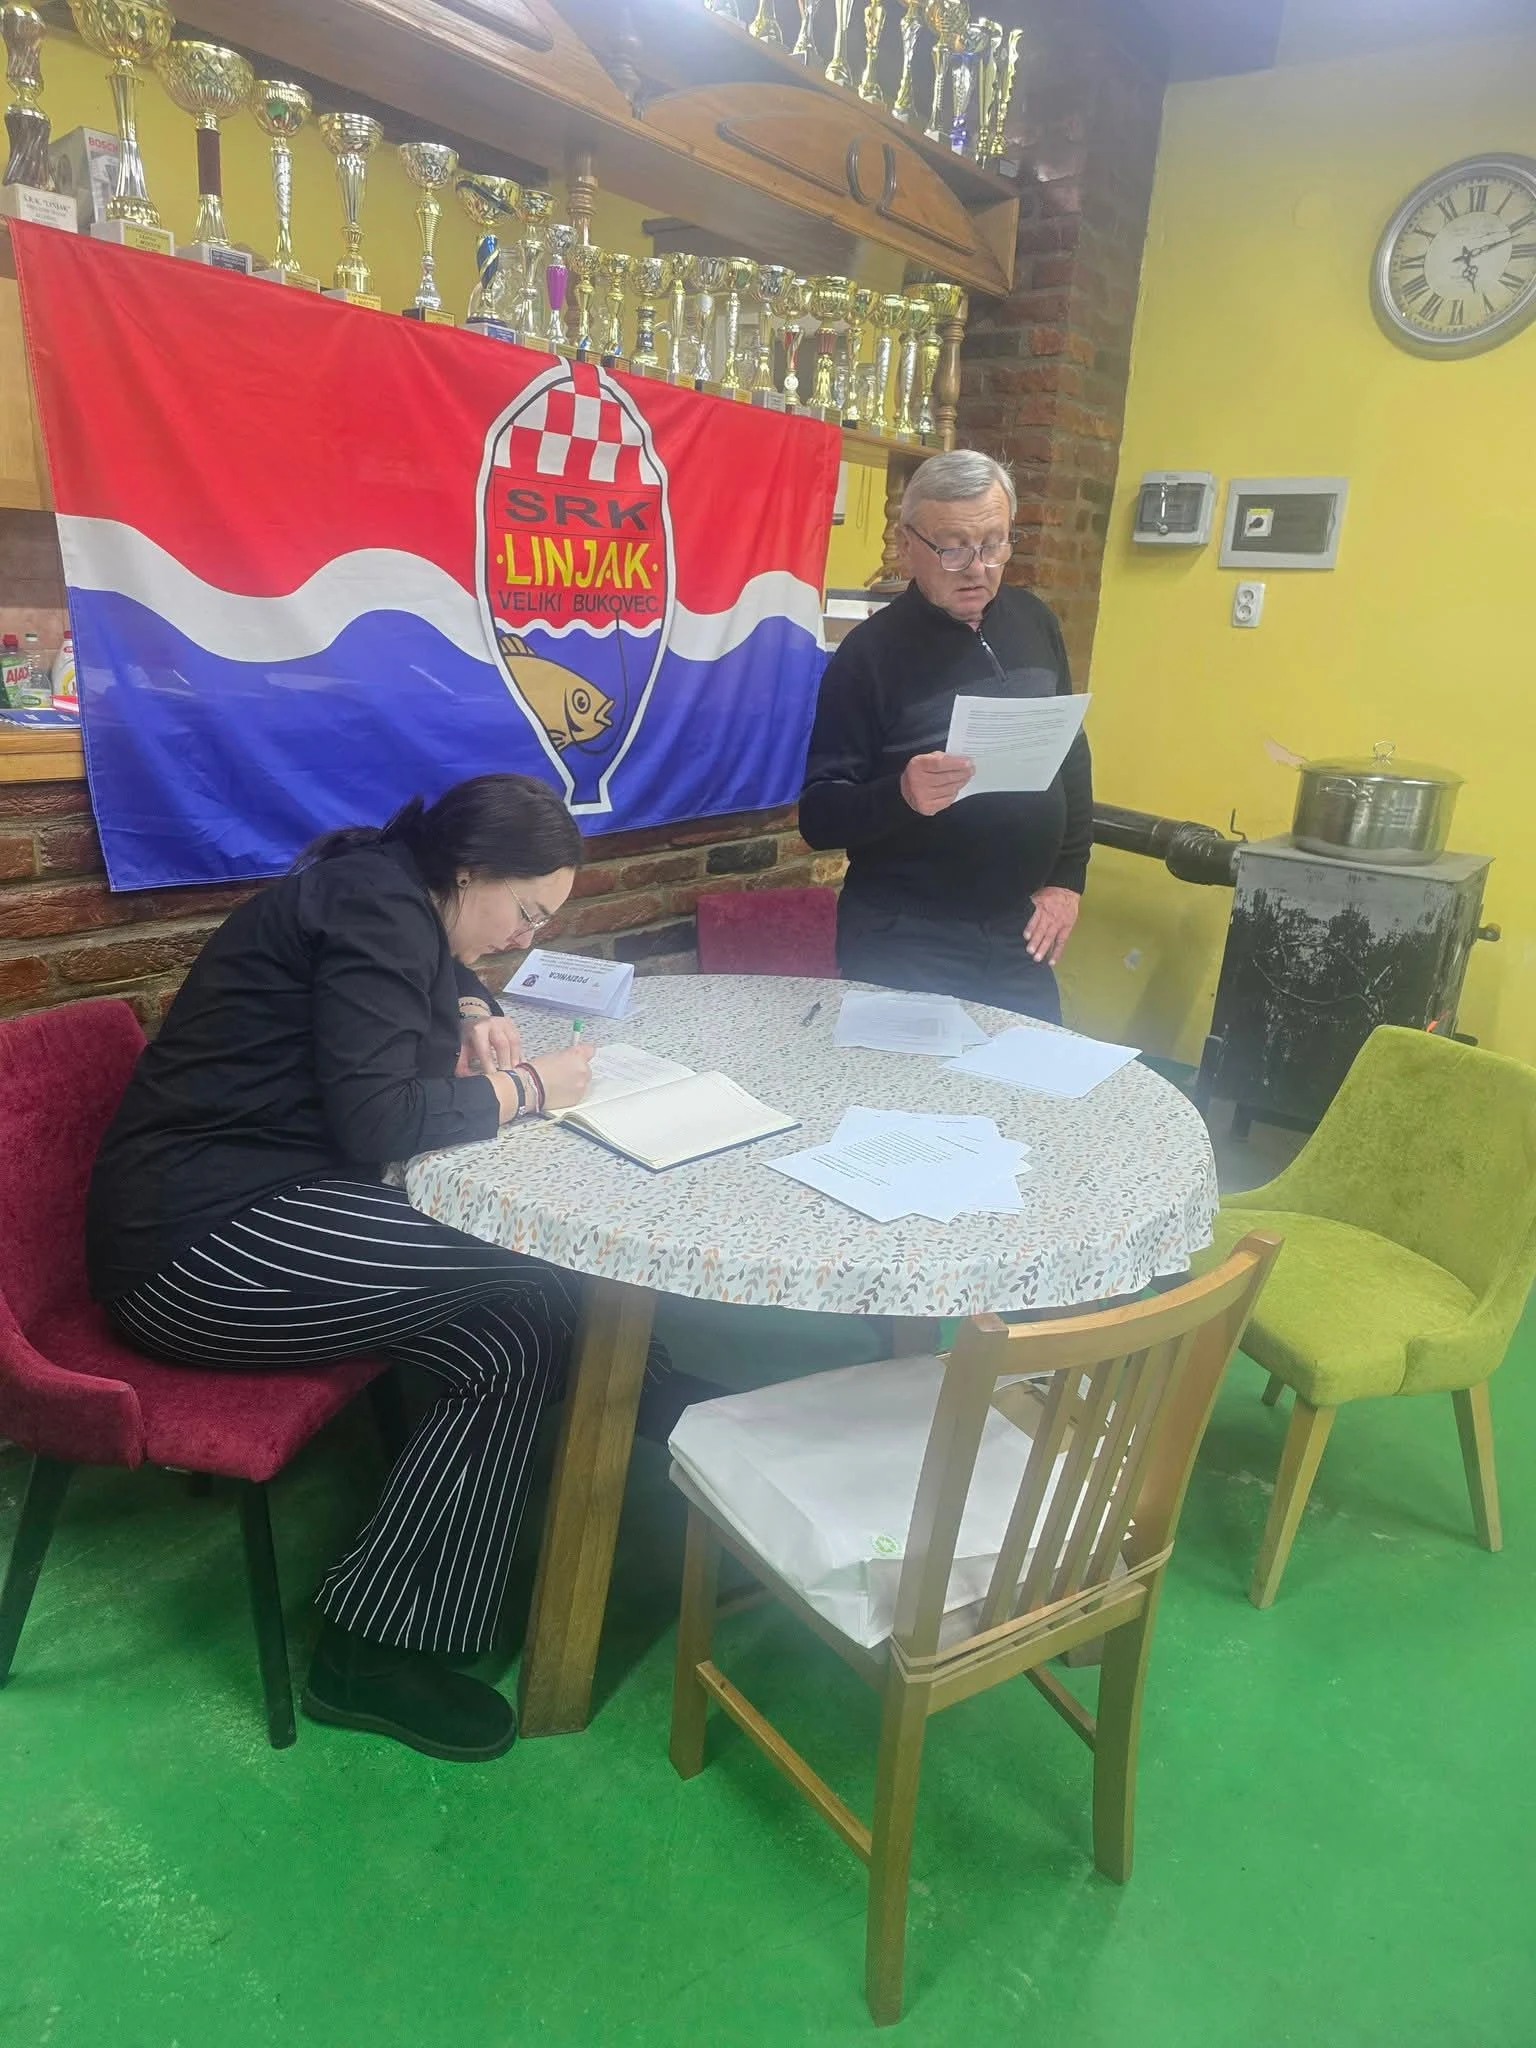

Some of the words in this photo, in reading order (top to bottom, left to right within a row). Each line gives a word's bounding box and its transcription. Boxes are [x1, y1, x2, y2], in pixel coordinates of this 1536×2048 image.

[88, 137, 119, 151] BOSCH
[505, 488, 652, 531] SRK
[498, 590, 562, 612] VELIKI
[572, 593, 660, 613] BUKOVEC
